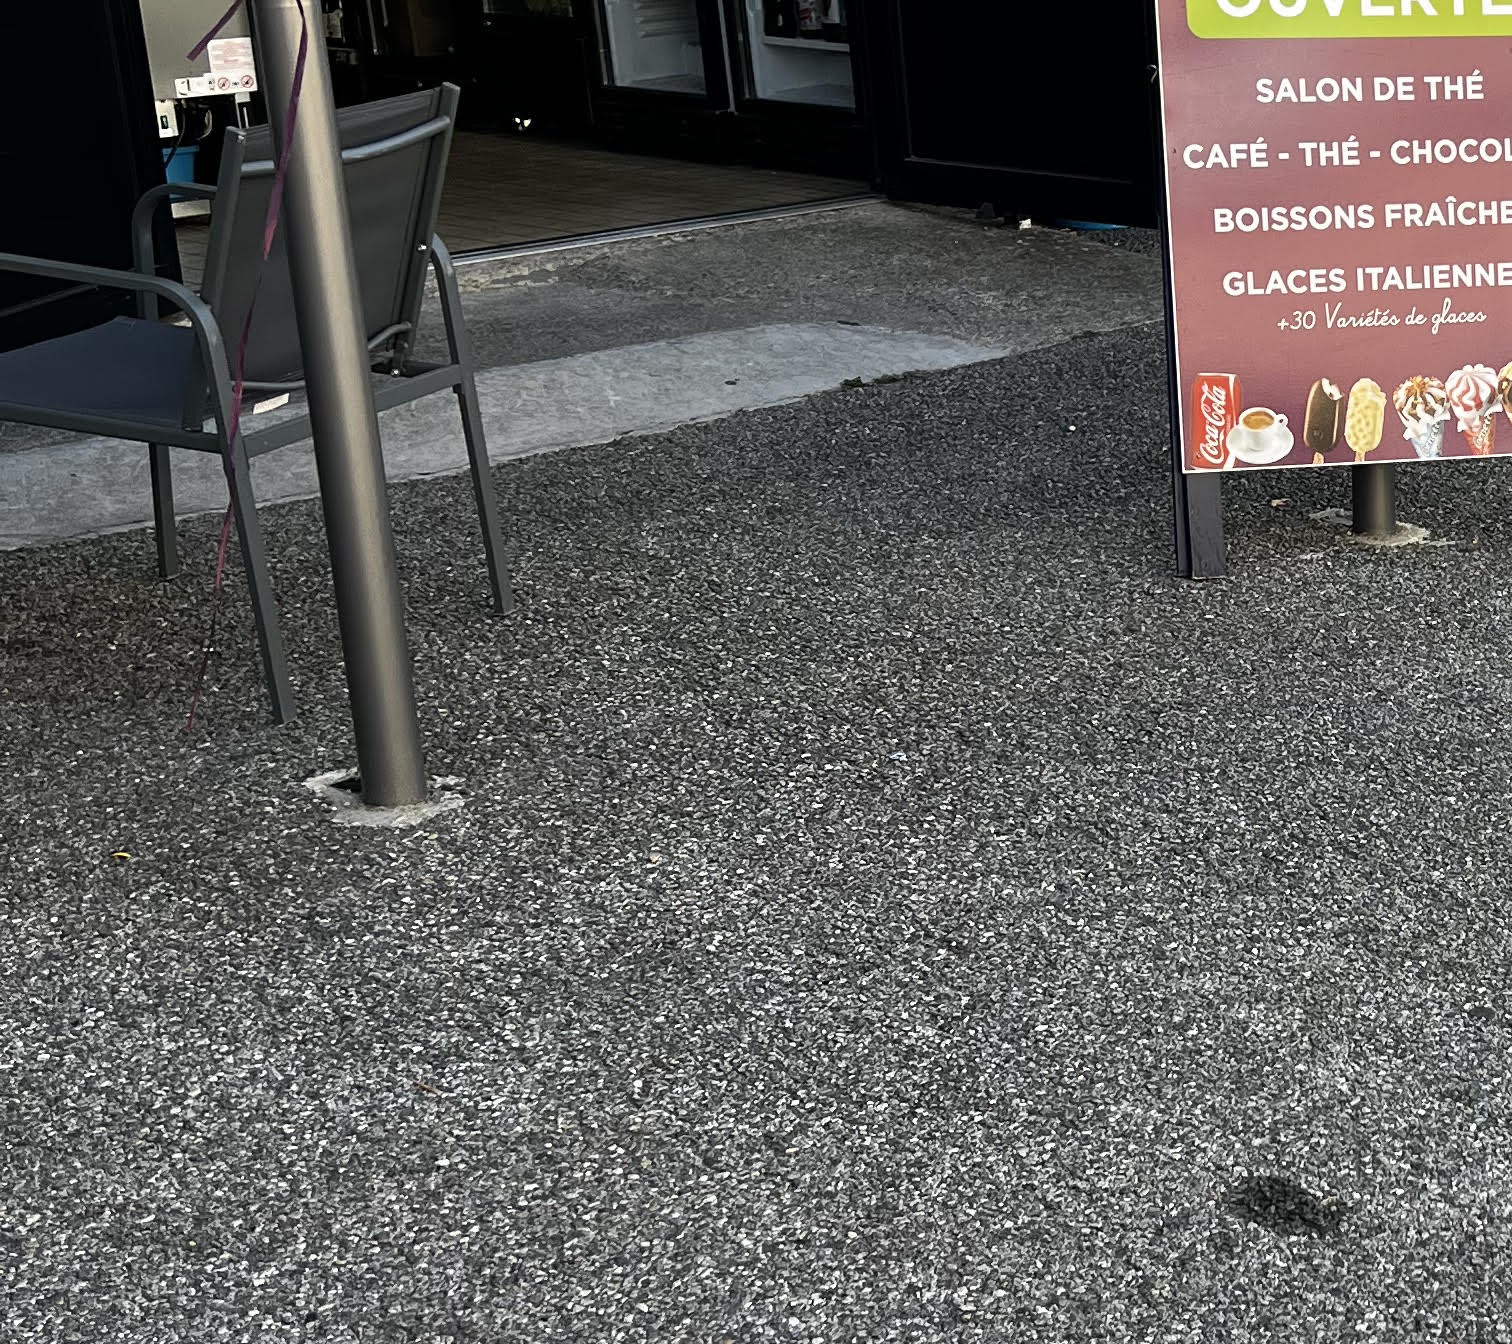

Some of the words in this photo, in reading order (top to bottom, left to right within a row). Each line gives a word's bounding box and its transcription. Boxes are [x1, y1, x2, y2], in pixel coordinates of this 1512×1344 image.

[1255, 77, 1363, 104] SALON
[1373, 76, 1415, 101] DE
[1423, 69, 1485, 101] THÉ
[1182, 136, 1269, 169] CAFÉ
[1298, 134, 1361, 167] THÉ
[1213, 203, 1375, 233] BOISSONS
[1222, 267, 1347, 296] GLACES
[1277, 310, 1316, 331] +30
[1324, 302, 1401, 329] Variétés
[1404, 306, 1428, 326] de
[1431, 297, 1488, 335] glaces
